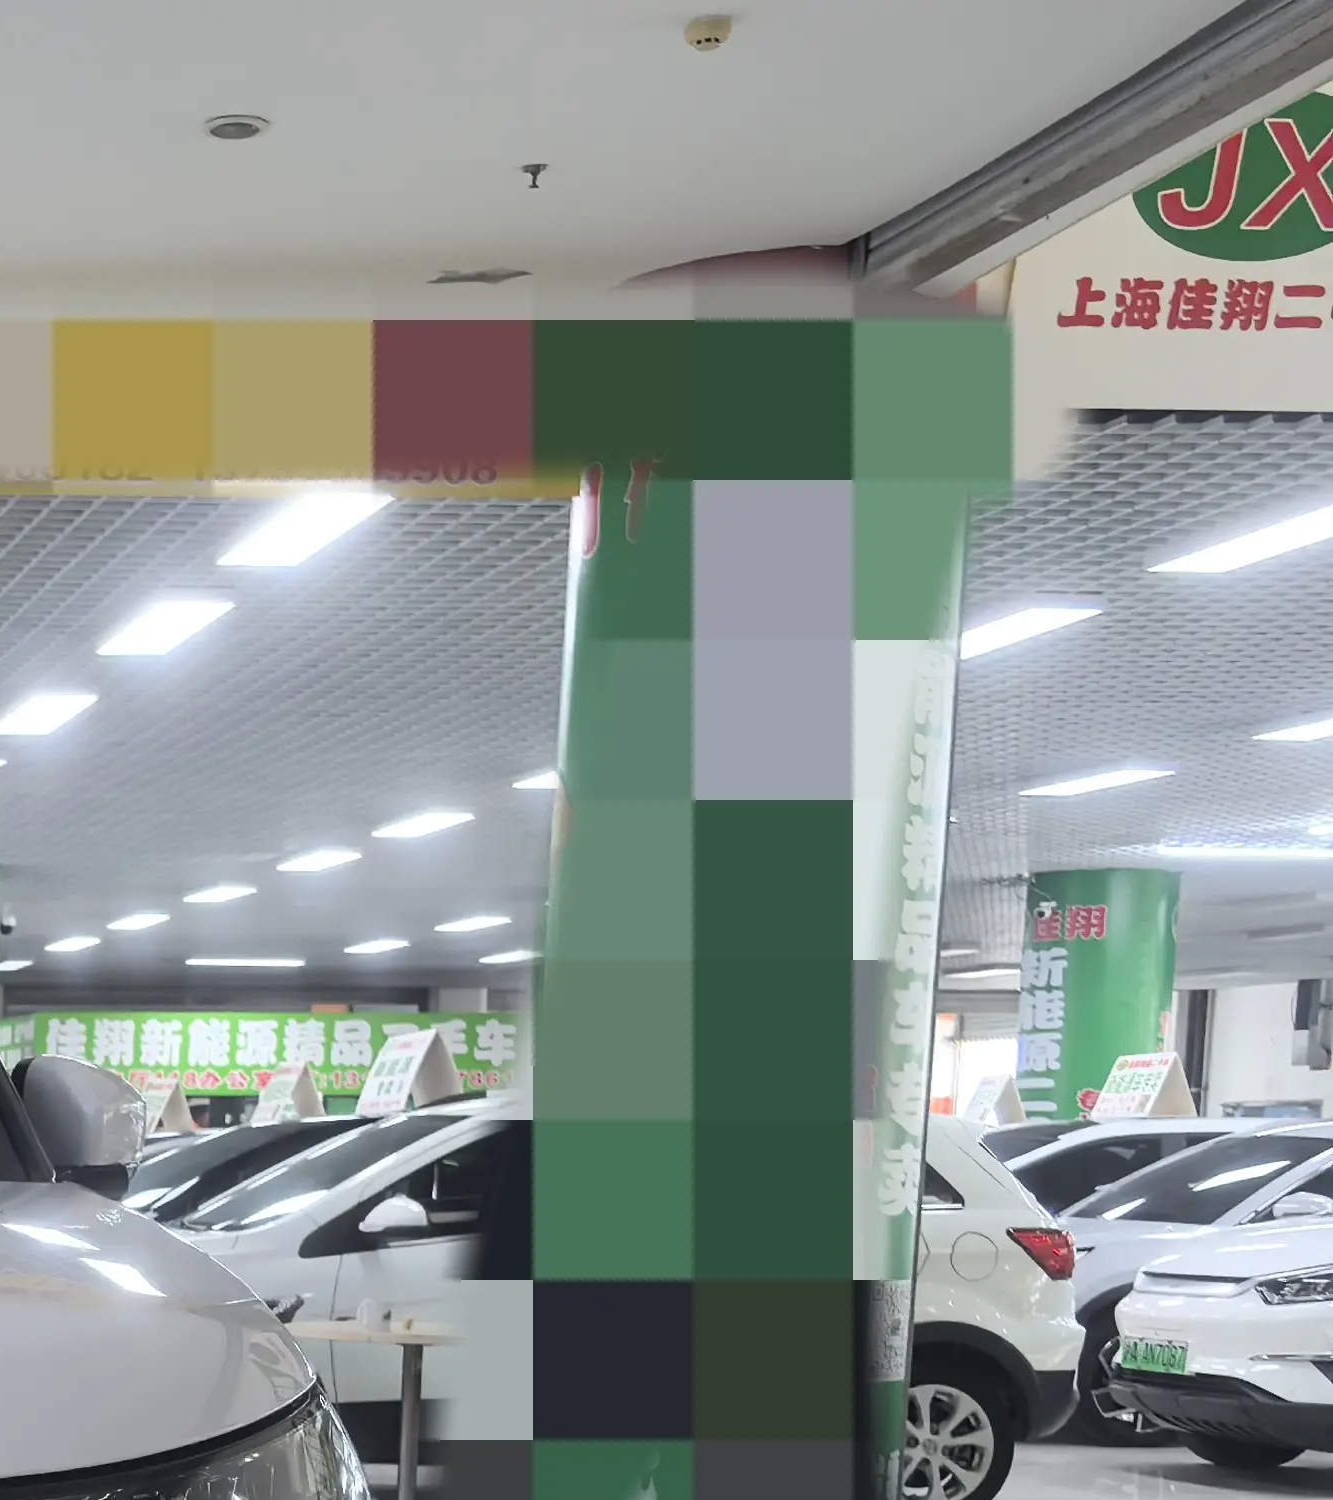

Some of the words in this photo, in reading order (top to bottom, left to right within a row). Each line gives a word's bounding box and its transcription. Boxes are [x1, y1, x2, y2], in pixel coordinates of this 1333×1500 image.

[1157, 118, 1333, 232] JX
[1056, 276, 1333, 331] 上海佳翔二
